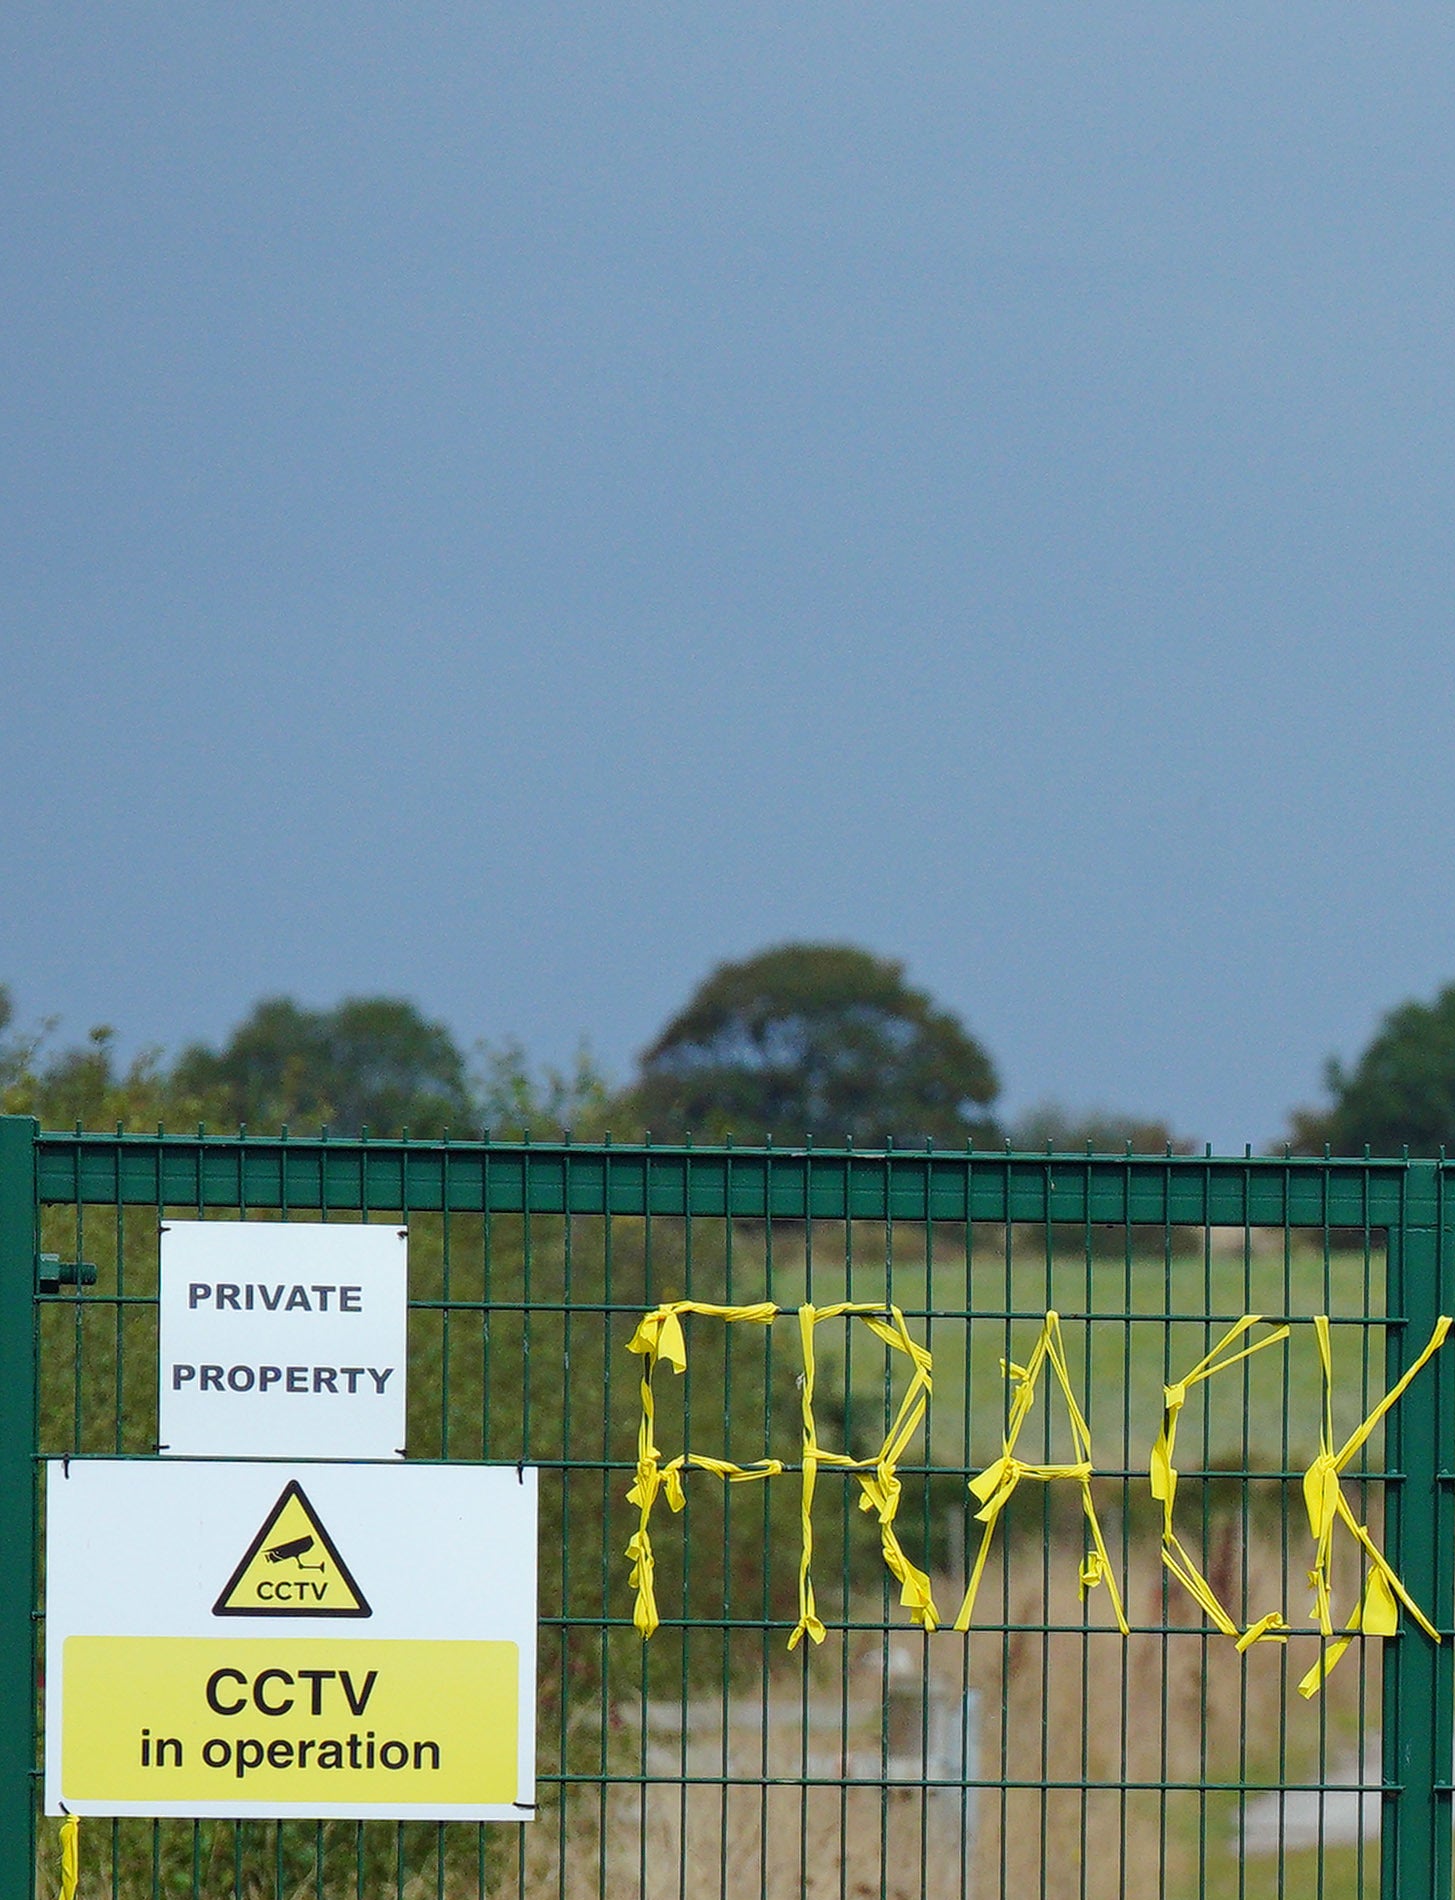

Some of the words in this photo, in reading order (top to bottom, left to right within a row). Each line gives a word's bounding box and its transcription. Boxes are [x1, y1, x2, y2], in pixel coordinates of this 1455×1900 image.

[189, 1283, 362, 1312] PRIVATE
[172, 1364, 394, 1394] PROPERTY
[627, 1301, 1453, 1666] FRACK
[256, 1581, 328, 1602] CCTV
[205, 1668, 378, 1716] CCTV
[141, 1729, 183, 1768] in
[202, 1731, 440, 1778] operation
